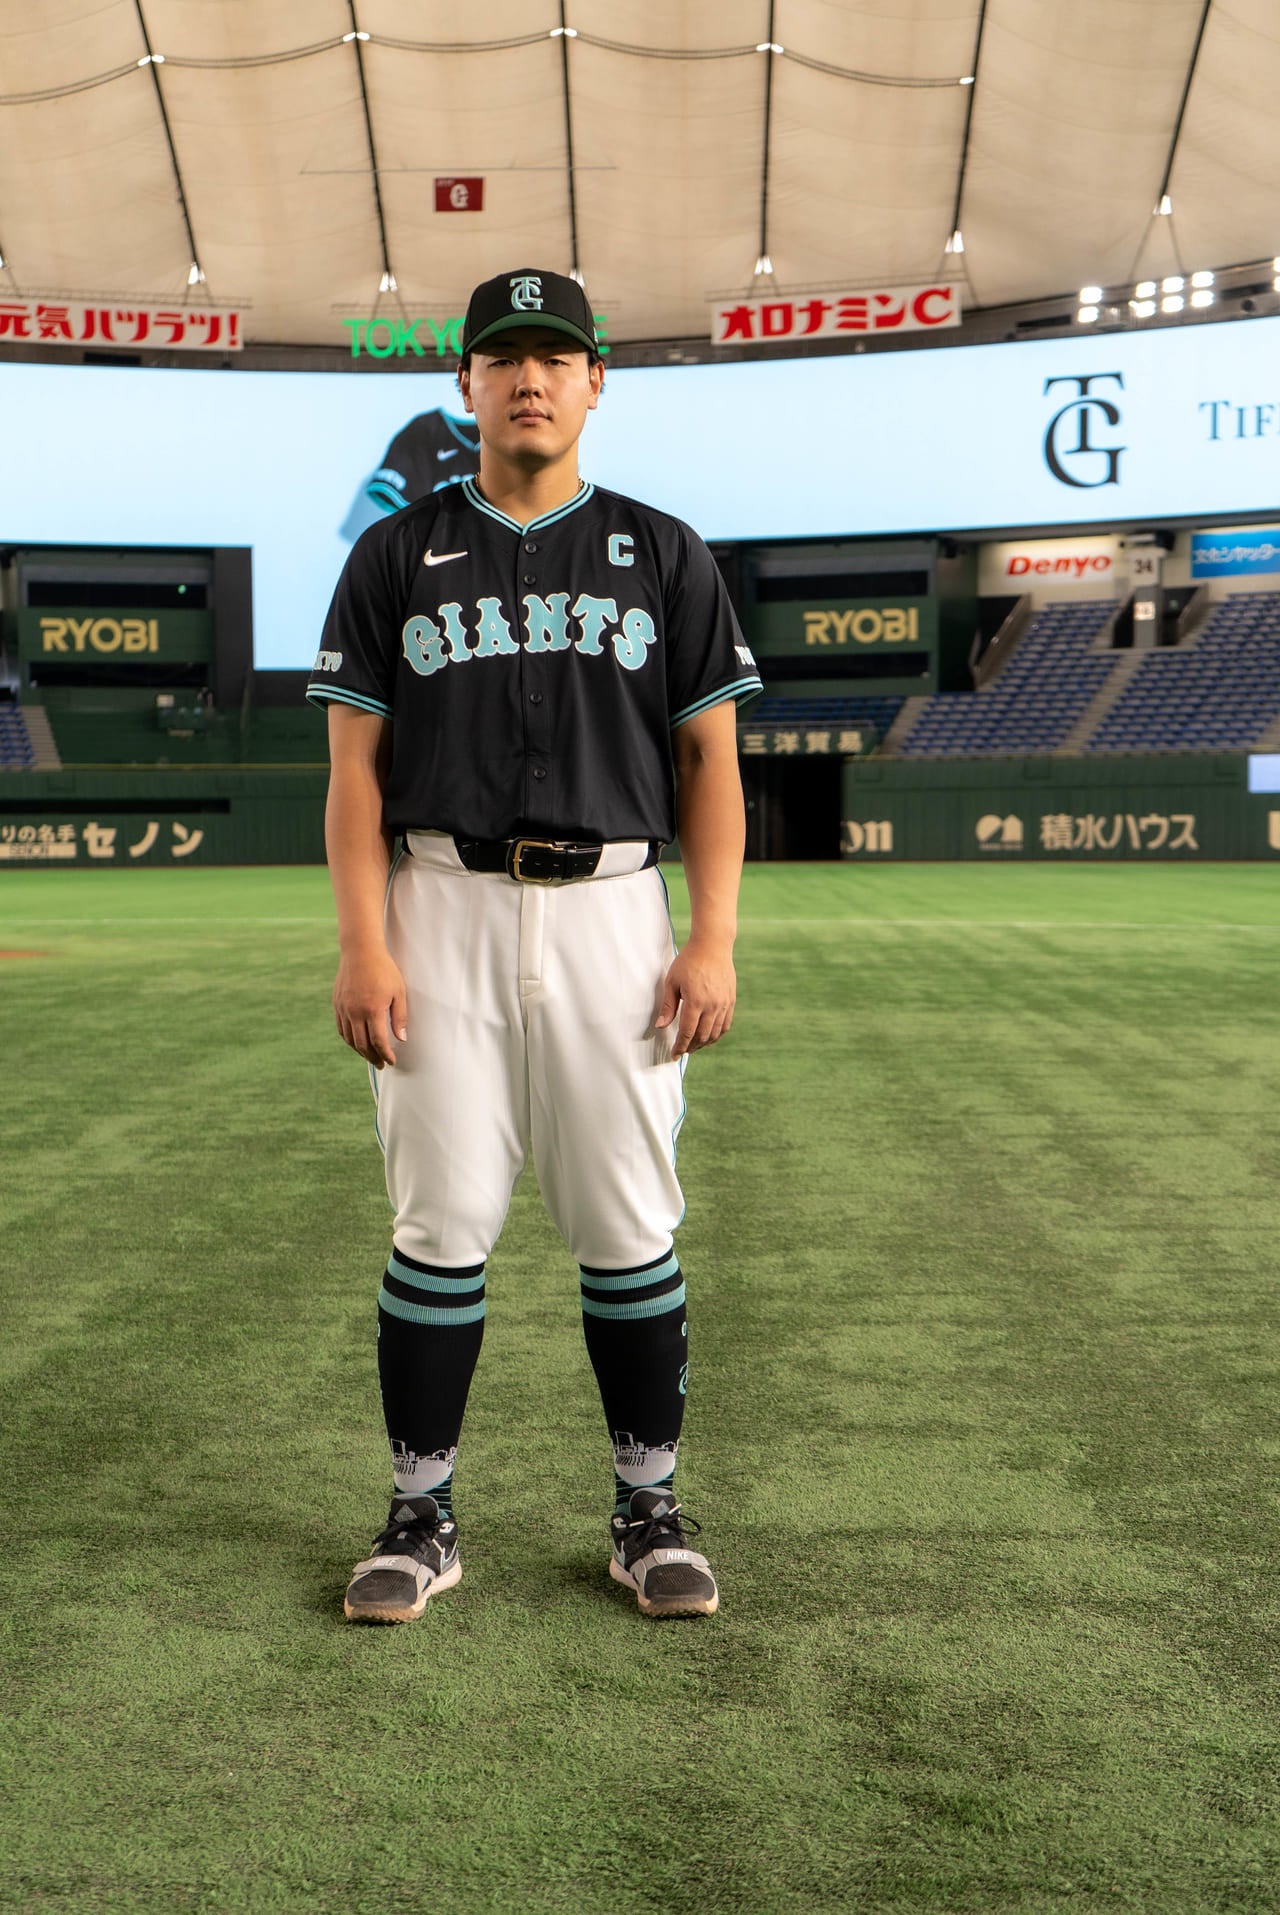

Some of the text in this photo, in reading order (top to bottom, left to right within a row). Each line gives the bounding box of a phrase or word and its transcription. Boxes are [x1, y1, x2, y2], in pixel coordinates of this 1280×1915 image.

[719, 287, 954, 341] オロナミンC
[1199, 400, 1280, 441] TIF
[608, 533, 635, 568] C
[1006, 554, 1112, 577] Denyo
[40, 617, 159, 653] RYOBI
[402, 592, 657, 676] GIANTS
[802, 607, 919, 645] RYOBI
[82, 821, 204, 858] セノン
[1039, 813, 1199, 850] 積水ハウス
[666, 1550, 689, 1561] NIKE
